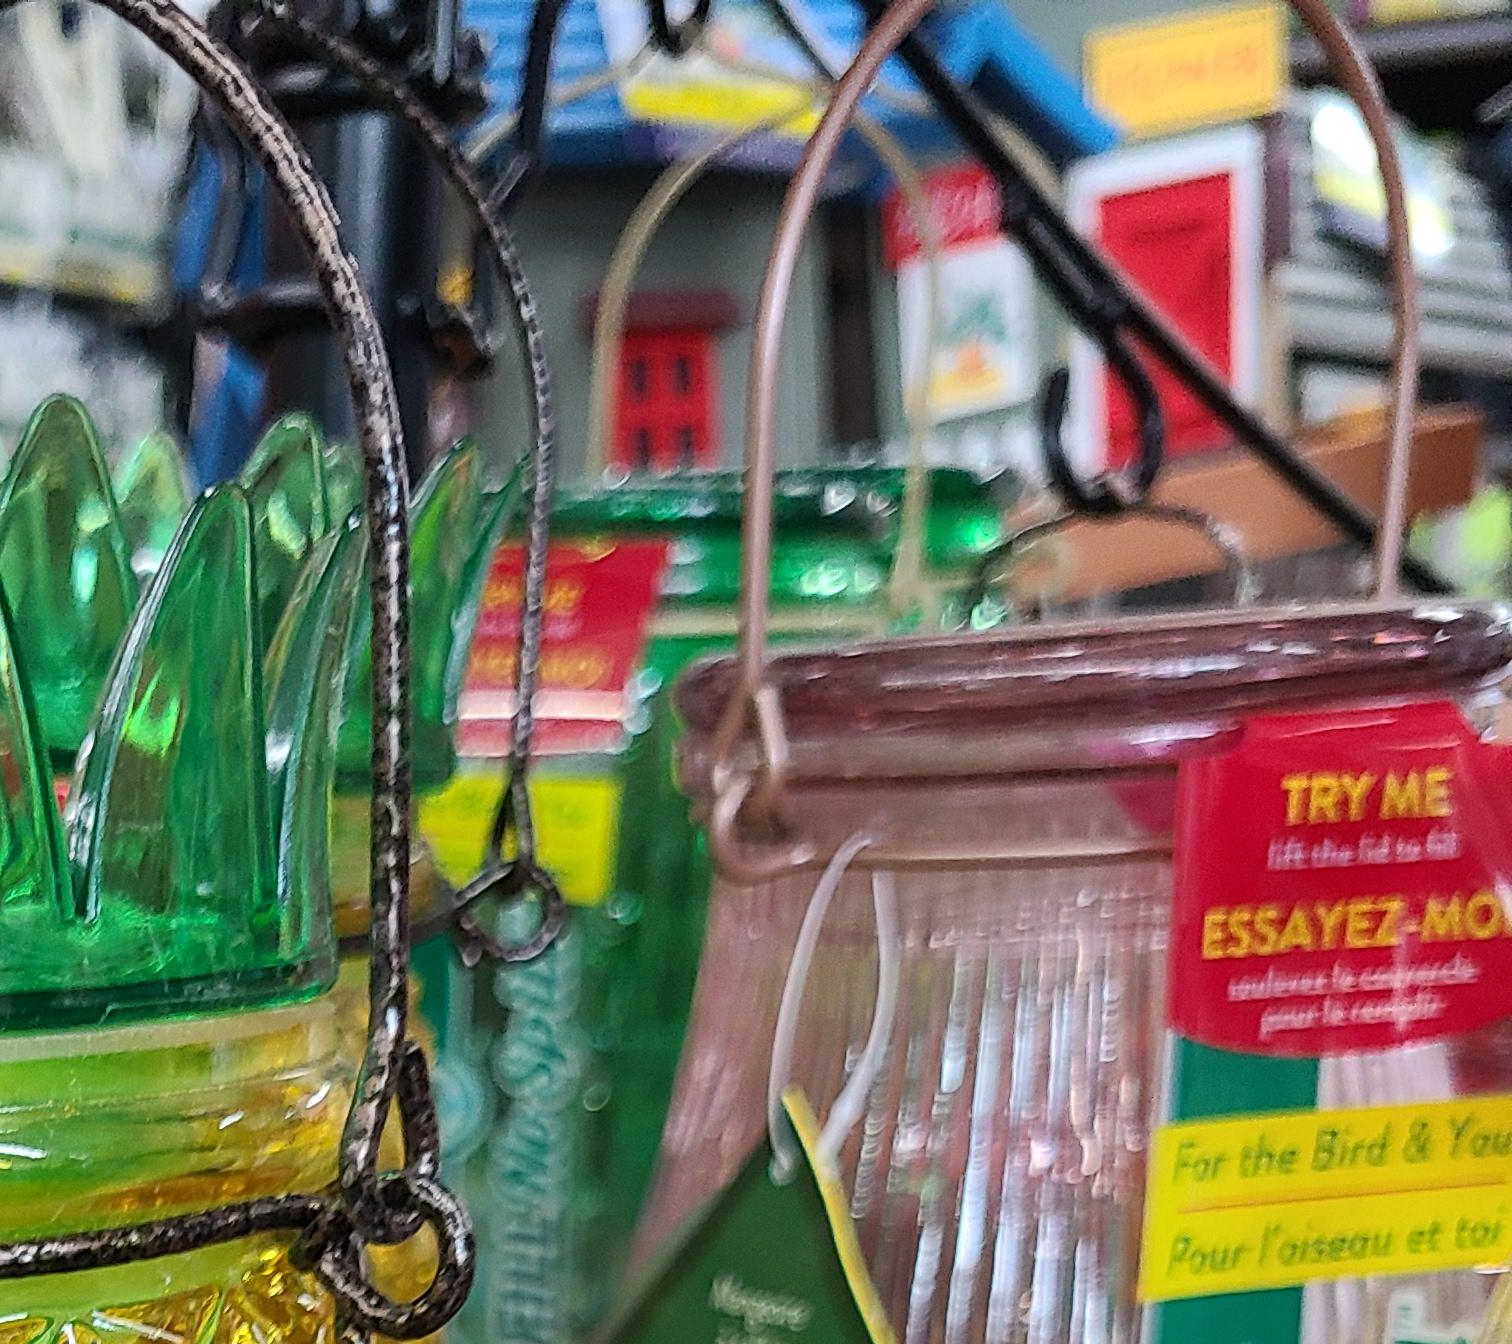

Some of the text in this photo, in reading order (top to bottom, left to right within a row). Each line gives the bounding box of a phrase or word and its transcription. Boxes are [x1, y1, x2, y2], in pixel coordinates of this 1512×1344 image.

[1280, 765, 1455, 827] TRY ME
[1172, 1138, 1226, 1186] For
[1238, 1132, 1299, 1179] the
[1310, 1120, 1394, 1173] Bird
[1402, 1117, 1432, 1165] &
[1166, 1202, 1509, 1279] Pour l'oiseau et toi
